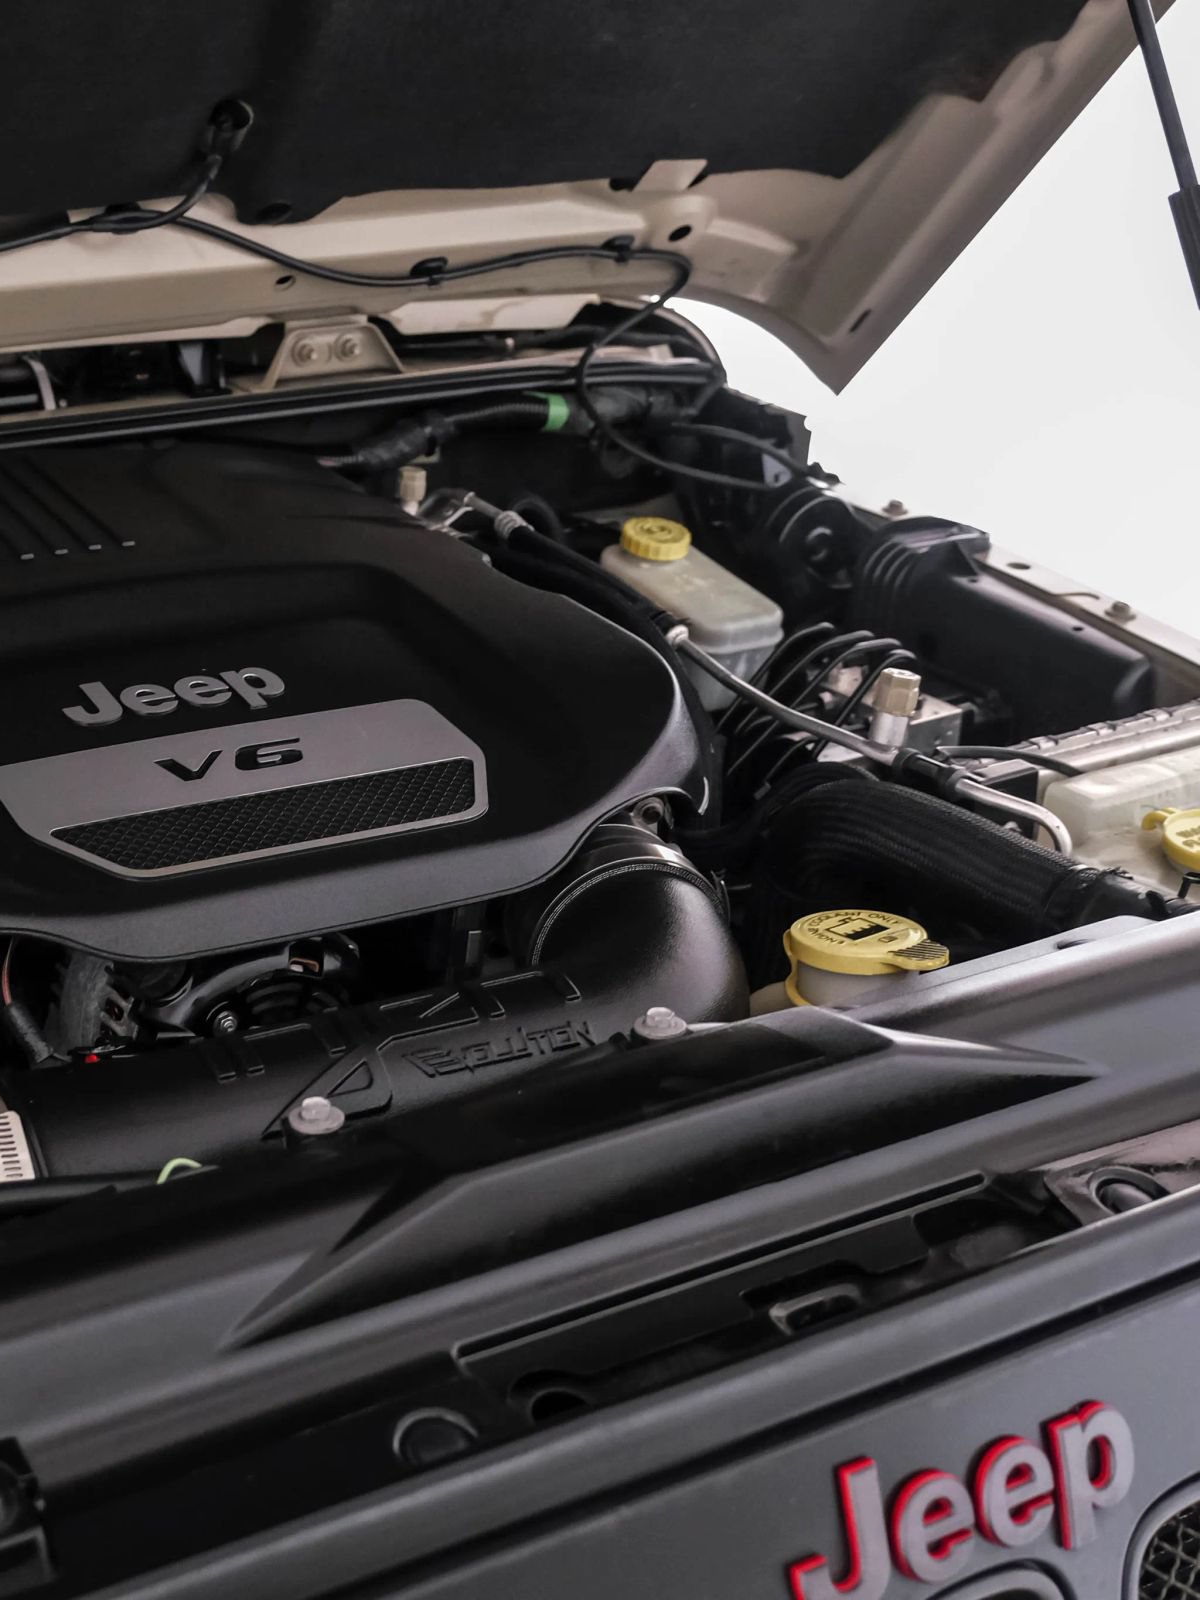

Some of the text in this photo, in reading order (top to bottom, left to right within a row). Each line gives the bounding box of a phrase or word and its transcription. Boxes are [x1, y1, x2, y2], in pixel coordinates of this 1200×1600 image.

[62, 667, 285, 727] Jeep
[154, 737, 303, 782] V6
[809, 911, 862, 928] COOLANT
[868, 912, 900, 925] ONLY
[788, 1399, 1135, 1600] Jeep
